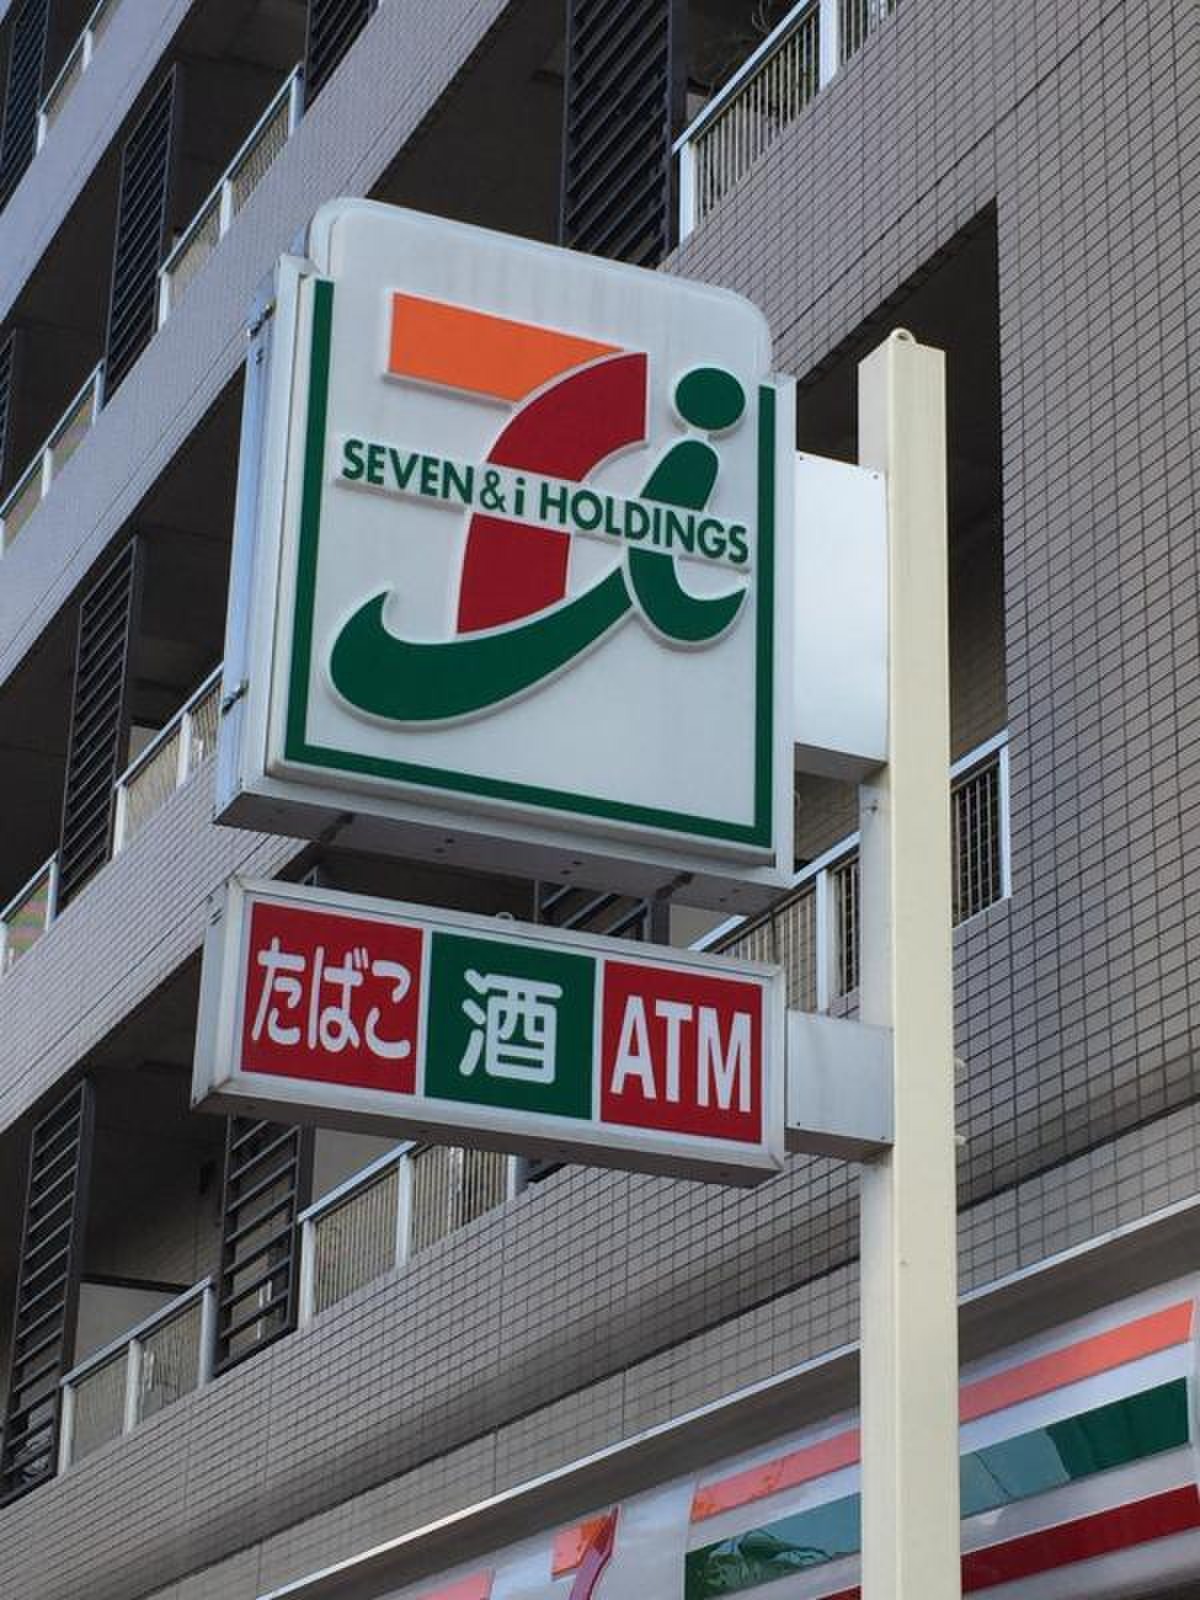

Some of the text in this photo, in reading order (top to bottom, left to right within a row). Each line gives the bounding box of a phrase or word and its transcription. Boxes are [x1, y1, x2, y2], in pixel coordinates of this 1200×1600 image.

[539, 486, 749, 564] HOLDINGS
[253, 937, 411, 1058] たばこ
[459, 969, 563, 1084] 酒
[610, 995, 752, 1112] ATM
